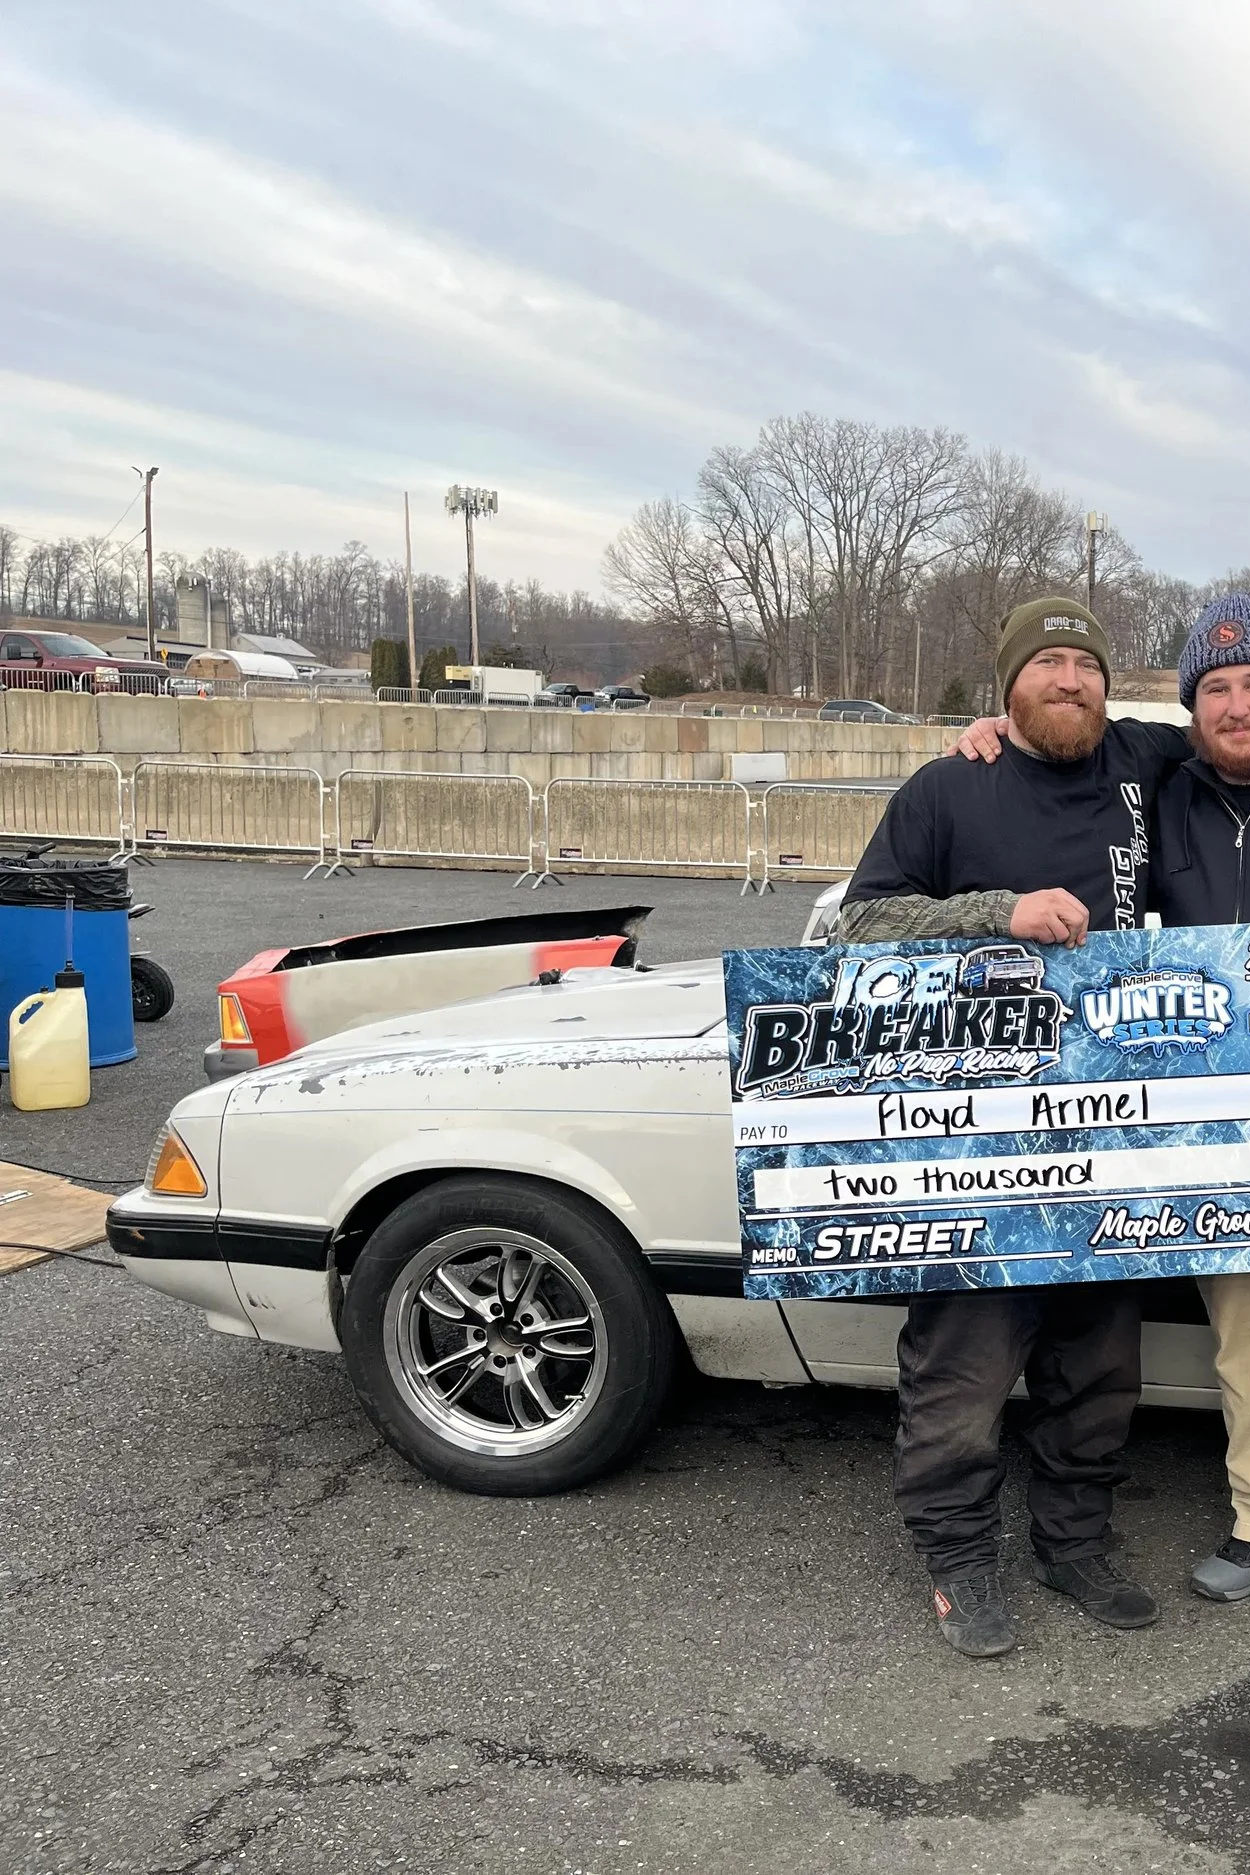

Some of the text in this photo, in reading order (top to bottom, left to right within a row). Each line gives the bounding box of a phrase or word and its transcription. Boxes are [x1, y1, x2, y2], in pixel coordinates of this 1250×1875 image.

[1122, 971, 1203, 988] MapleGrove
[1083, 982, 1233, 1031] WINTER
[743, 996, 1058, 1087] BREAKER
[1112, 1018, 1212, 1042] SERIES
[864, 1045, 1040, 1080] No Prep Racing
[740, 1124, 788, 1140] PAY TO
[878, 1084, 1149, 1138] Floyd Armel
[824, 1158, 1095, 1200] two thousand
[752, 1219, 985, 1264] MEMO STREET
[1089, 1207, 1186, 1249] Maple
